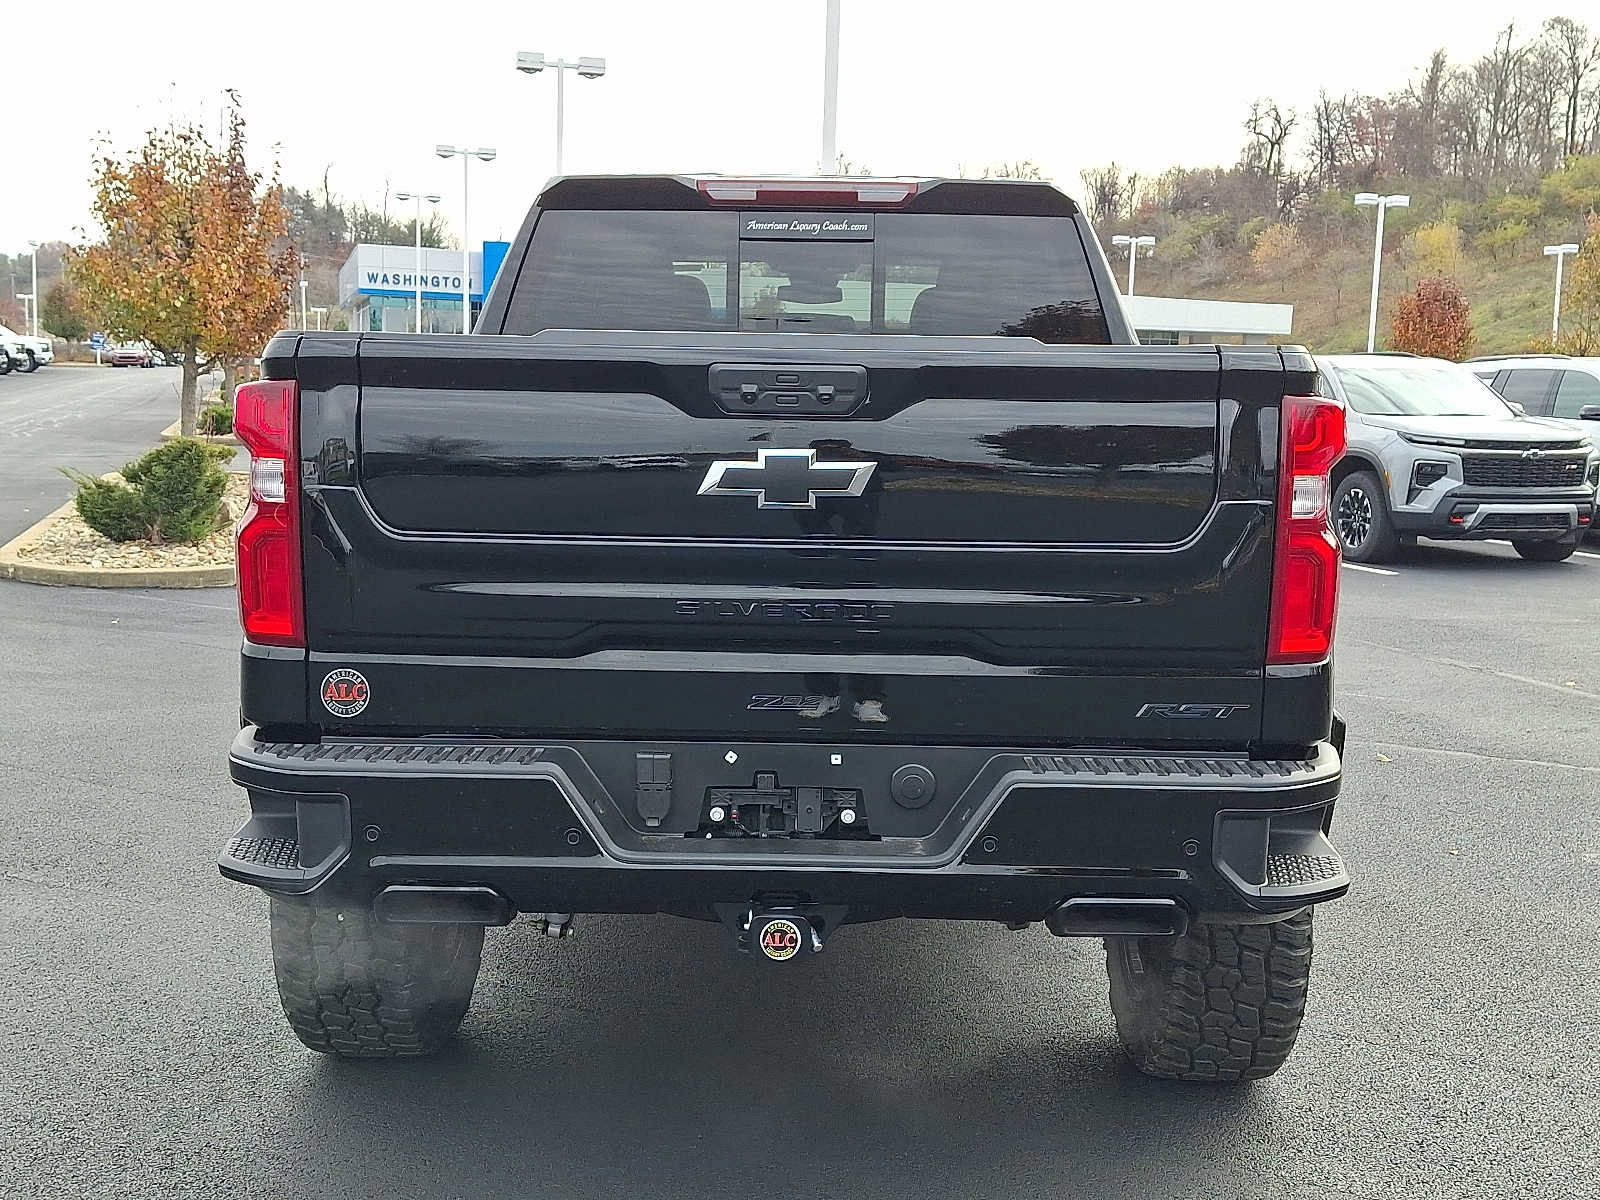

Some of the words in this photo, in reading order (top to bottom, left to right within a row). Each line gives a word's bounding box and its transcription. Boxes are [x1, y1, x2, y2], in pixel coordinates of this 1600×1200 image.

[747, 219, 788, 230] American
[822, 219, 868, 231] Coach.com
[328, 671, 362, 683] AMERICAN
[324, 683, 367, 701] ALC
[1136, 703, 1250, 719] RST
[763, 932, 796, 947] ALC
